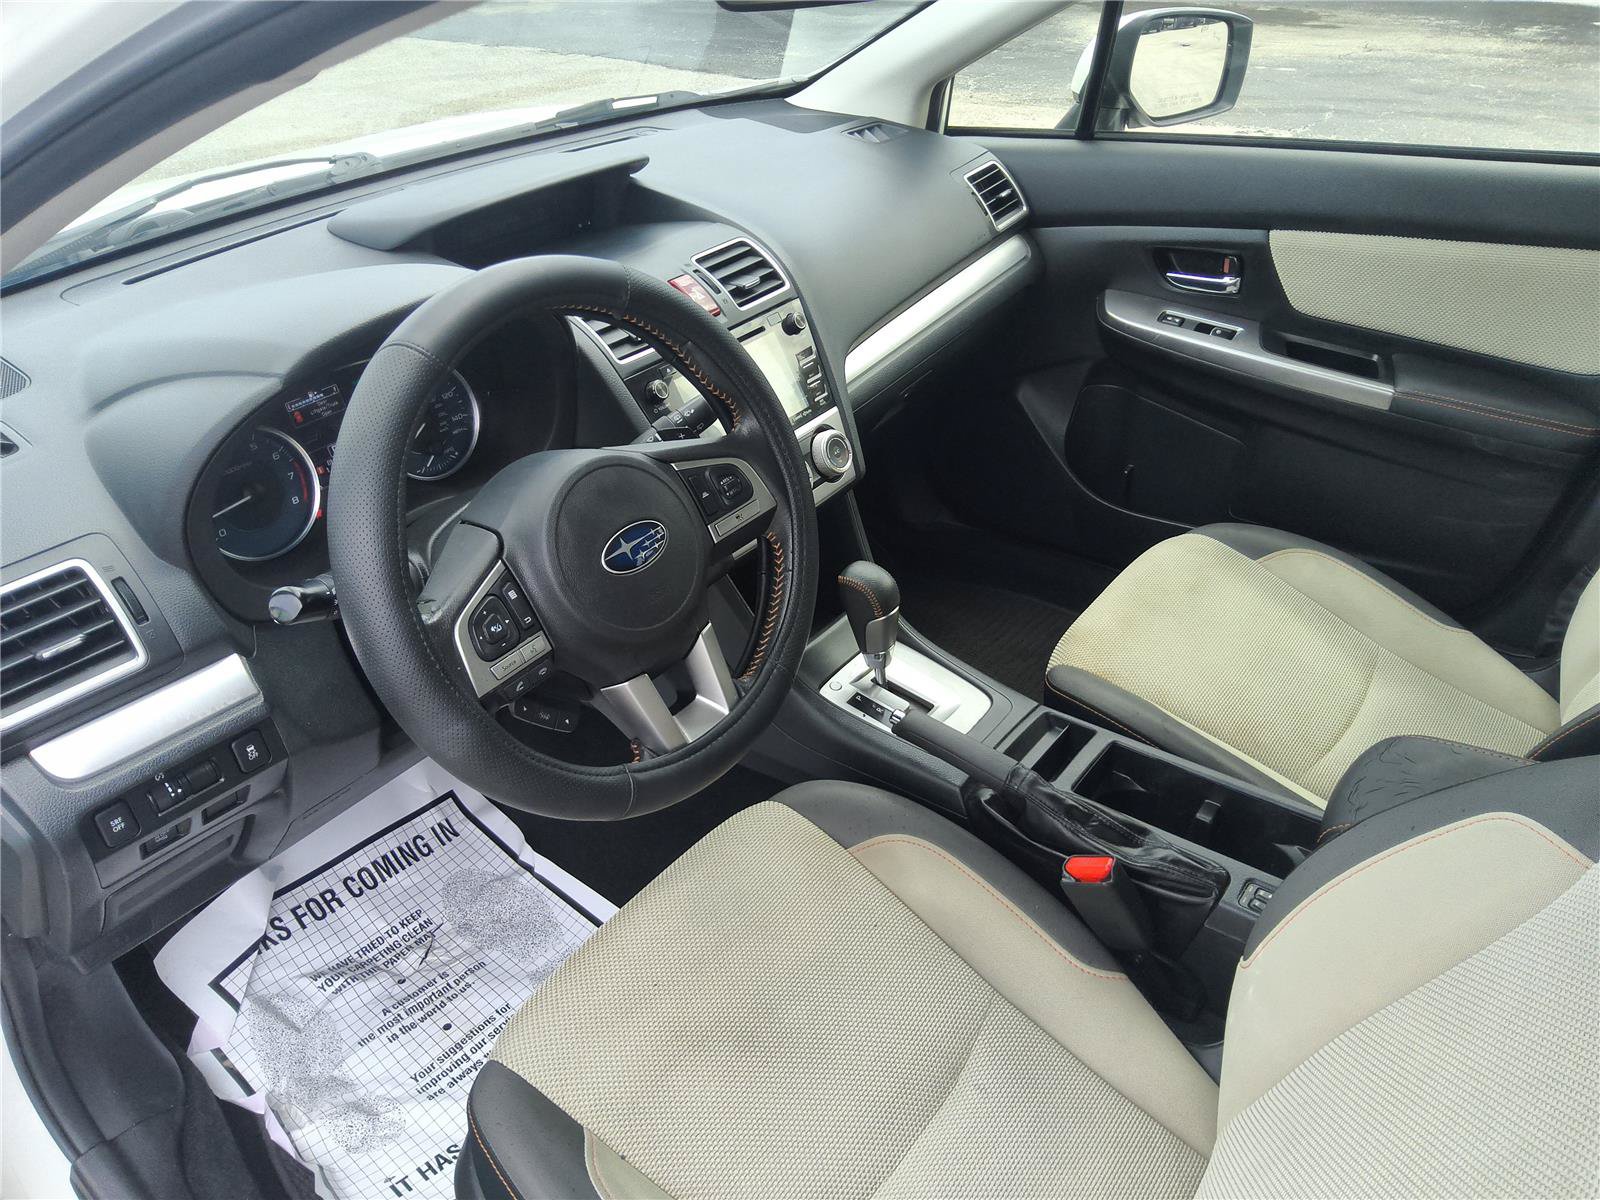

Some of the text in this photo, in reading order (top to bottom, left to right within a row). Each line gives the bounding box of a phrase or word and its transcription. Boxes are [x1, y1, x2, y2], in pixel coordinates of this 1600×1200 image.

[272, 452, 280, 460] 6
[287, 472, 294, 480] 7
[291, 496, 300, 505] 8
[110, 816, 123, 827] SRF
[112, 823, 126, 833] OFF
[290, 888, 345, 930] FOR
[343, 834, 435, 898] COMING
[430, 817, 460, 847] IN
[317, 918, 433, 993] YOUR CARPETING CLEAN
[327, 956, 354, 973] HAVE
[354, 935, 385, 959] TRIED
[384, 925, 400, 939] TO
[398, 909, 423, 929] KEEP
[331, 975, 358, 995] WITH
[382, 944, 415, 969] PAPER
[381, 970, 450, 1016] A customer is
[357, 960, 487, 1047] the most important person
[385, 1032, 399, 1044] in
[398, 1020, 418, 1035] the
[417, 1000, 448, 1023] world
[446, 992, 459, 1002] to
[410, 1002, 512, 1083] Your suggestions for
[416, 1053, 471, 1095] improving
[469, 1037, 487, 1055] our
[426, 1059, 484, 1101] are always
[389, 1144, 460, 1198] IT HAS
